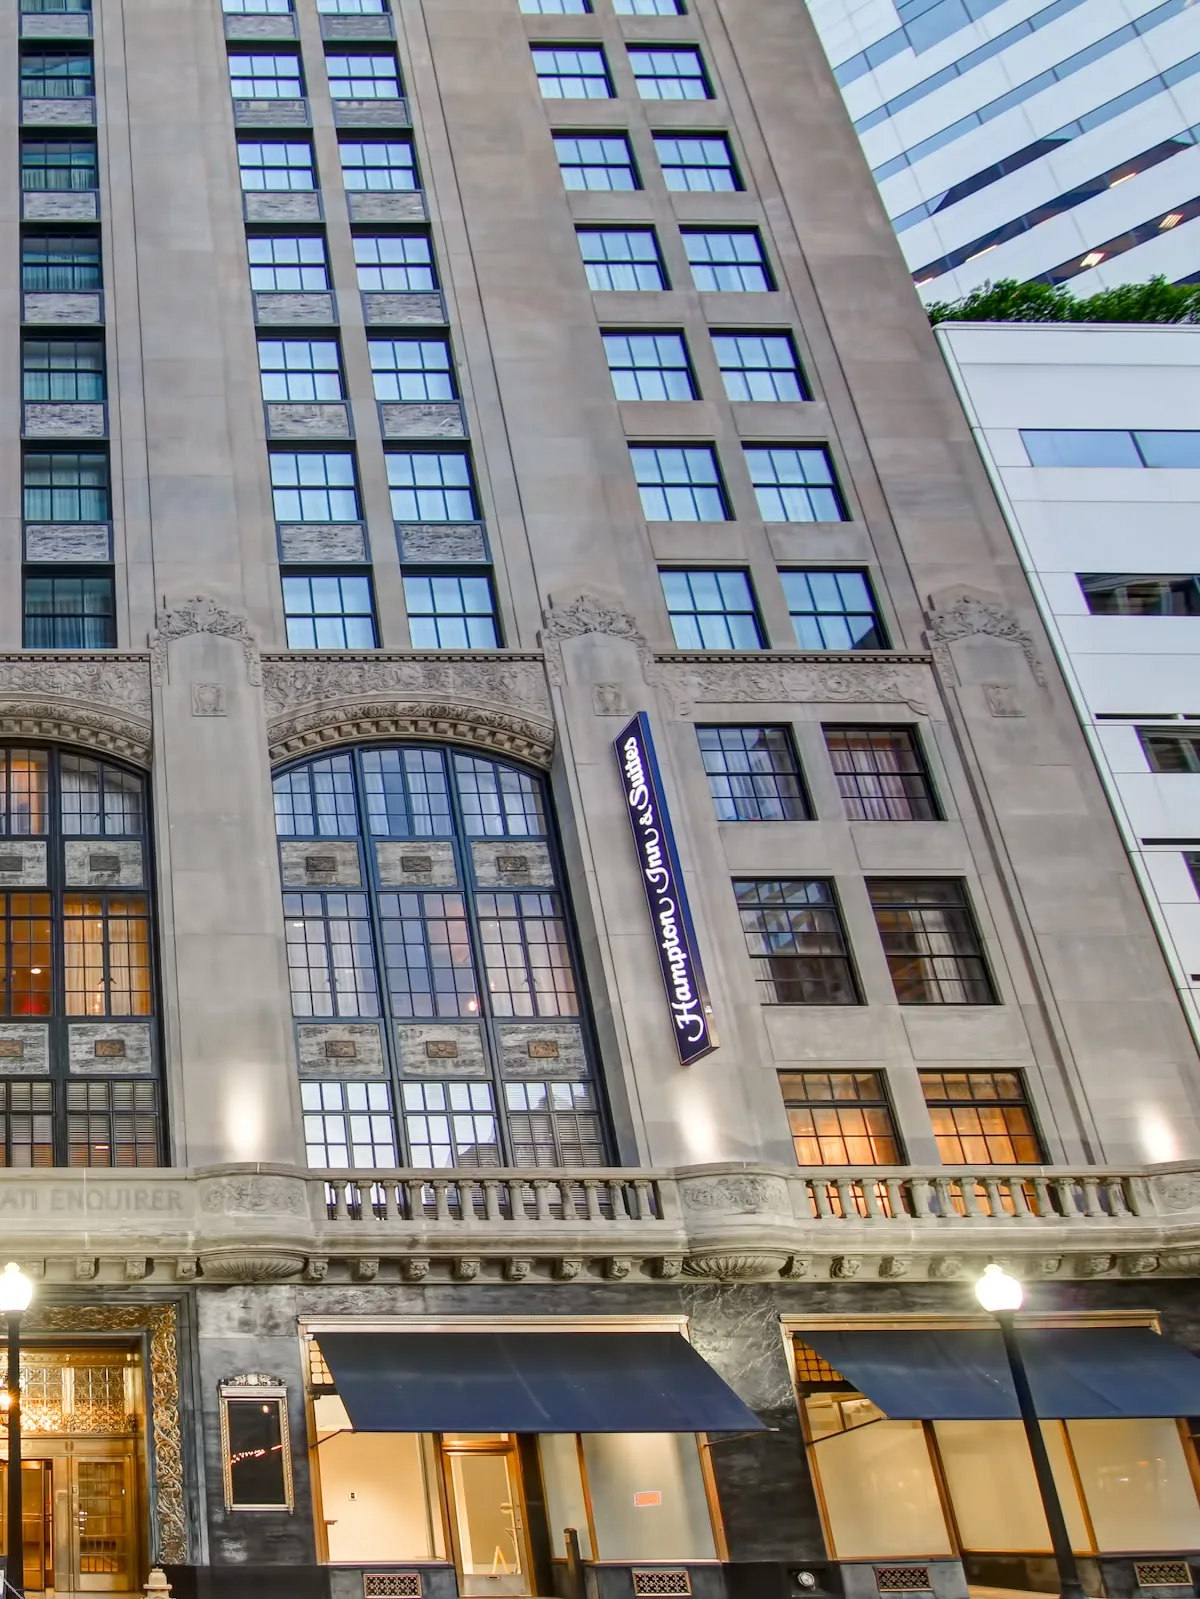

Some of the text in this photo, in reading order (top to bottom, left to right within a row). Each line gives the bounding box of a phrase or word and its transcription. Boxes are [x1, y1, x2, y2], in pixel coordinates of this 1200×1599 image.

[623, 736, 704, 1042] Hampton Inn & Suites
[50, 1188, 184, 1212] ENQUIRER
